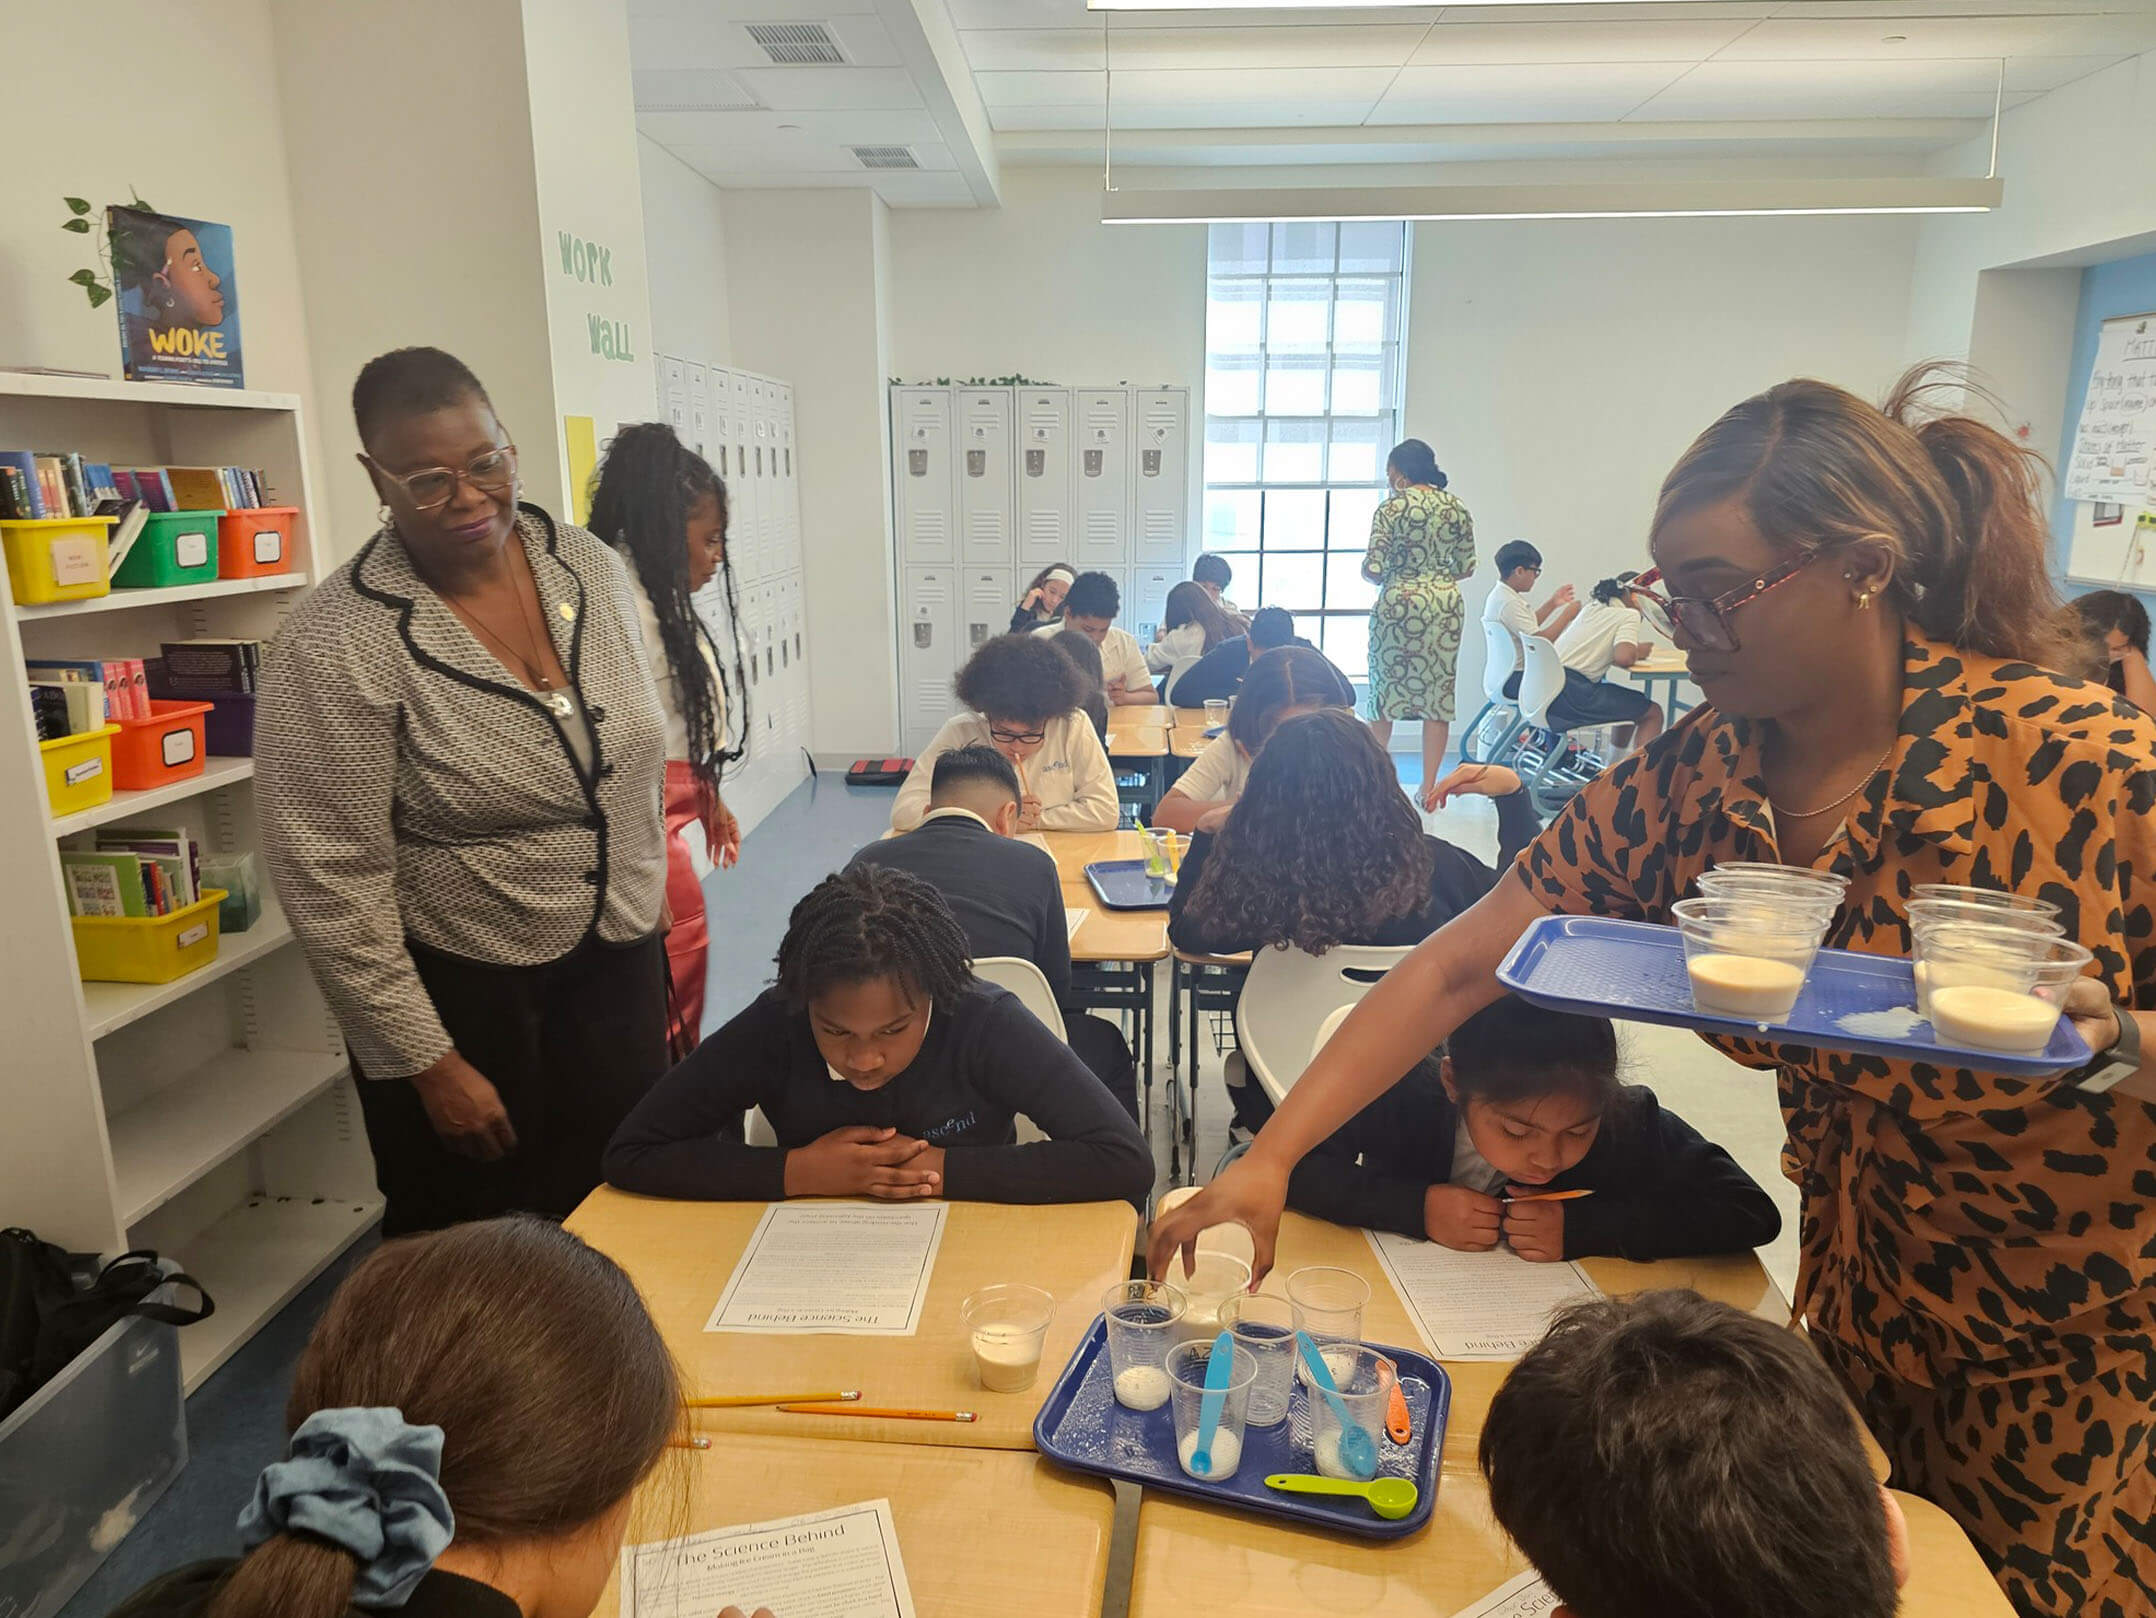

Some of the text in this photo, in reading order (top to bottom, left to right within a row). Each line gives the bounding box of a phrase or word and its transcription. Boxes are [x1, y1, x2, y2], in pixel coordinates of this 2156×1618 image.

[148, 327, 228, 359] WOKE
[2120, 336, 2156, 356] MATT
[922, 1111, 977, 1138] ascend
[747, 1313, 879, 1325] The Science Behind
[1464, 1340, 1516, 1350] Behind
[675, 1523, 846, 1566] The Science Behind
